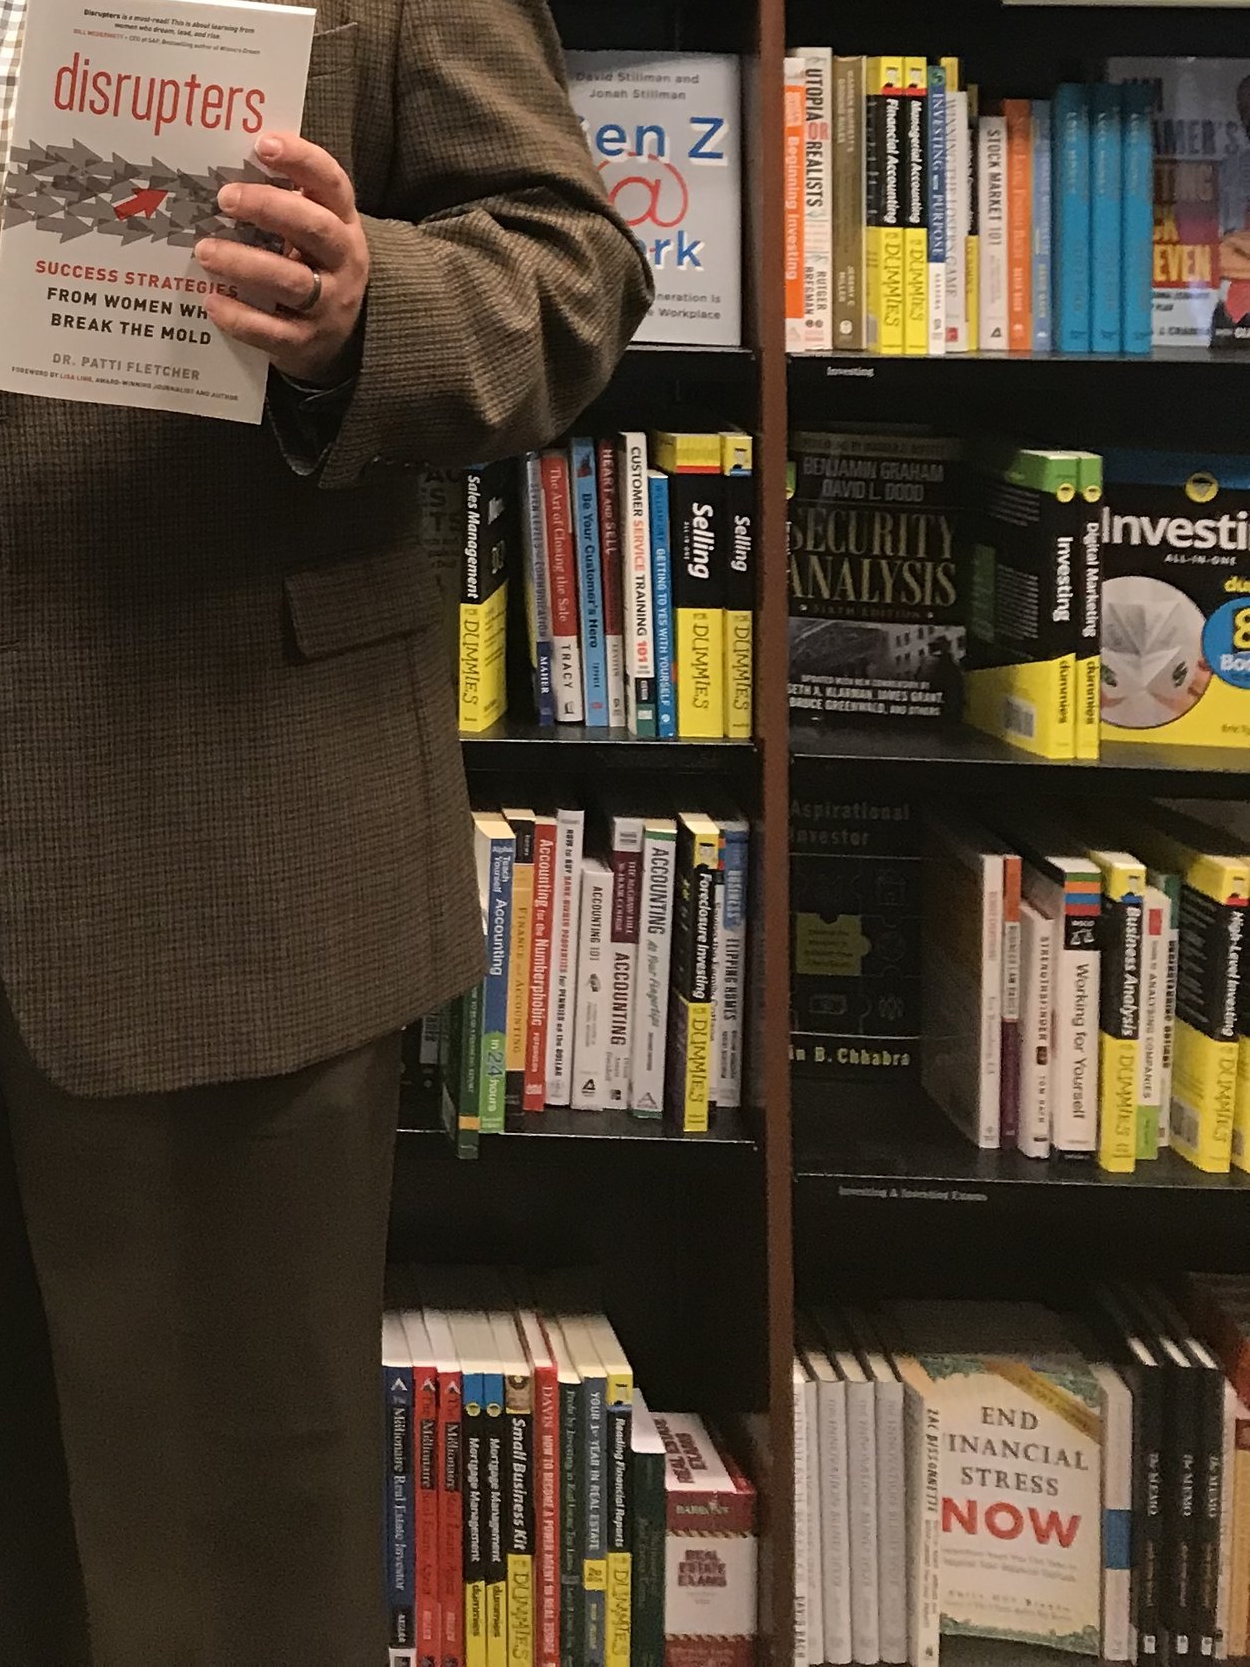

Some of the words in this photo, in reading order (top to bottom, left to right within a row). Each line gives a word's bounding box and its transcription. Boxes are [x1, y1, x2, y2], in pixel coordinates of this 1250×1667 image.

[54, 52, 265, 136] disrupters
[583, 117, 666, 159] en
[689, 117, 728, 164] Z
[35, 259, 119, 283] SUCCESS
[124, 271, 238, 298] STRATEGIES
[47, 287, 97, 310] FROM
[104, 294, 173, 316] WOMEN
[180, 301, 208, 320] WH
[51, 313, 112, 334] BREAK
[120, 319, 154, 338] THE
[161, 325, 211, 346] MOLD
[52, 352, 76, 367] DR.
[81, 356, 121, 372] PATTI
[126, 360, 199, 381] FLETCHER
[467, 475, 480, 509] Sales
[630, 447, 643, 516] CUSTOMER
[633, 520, 644, 572] SERVICE
[688, 502, 714, 580] Selling
[1102, 506, 1250, 550] Investi
[465, 512, 479, 599] Management
[635, 575, 647, 636] TRAINING
[637, 641, 648, 663] 101
[981, 1406, 1038, 1431] END
[949, 1433, 1089, 1471] INANCIAL
[960, 1467, 1059, 1497] STRESS
[941, 1497, 1081, 1549] NOW
